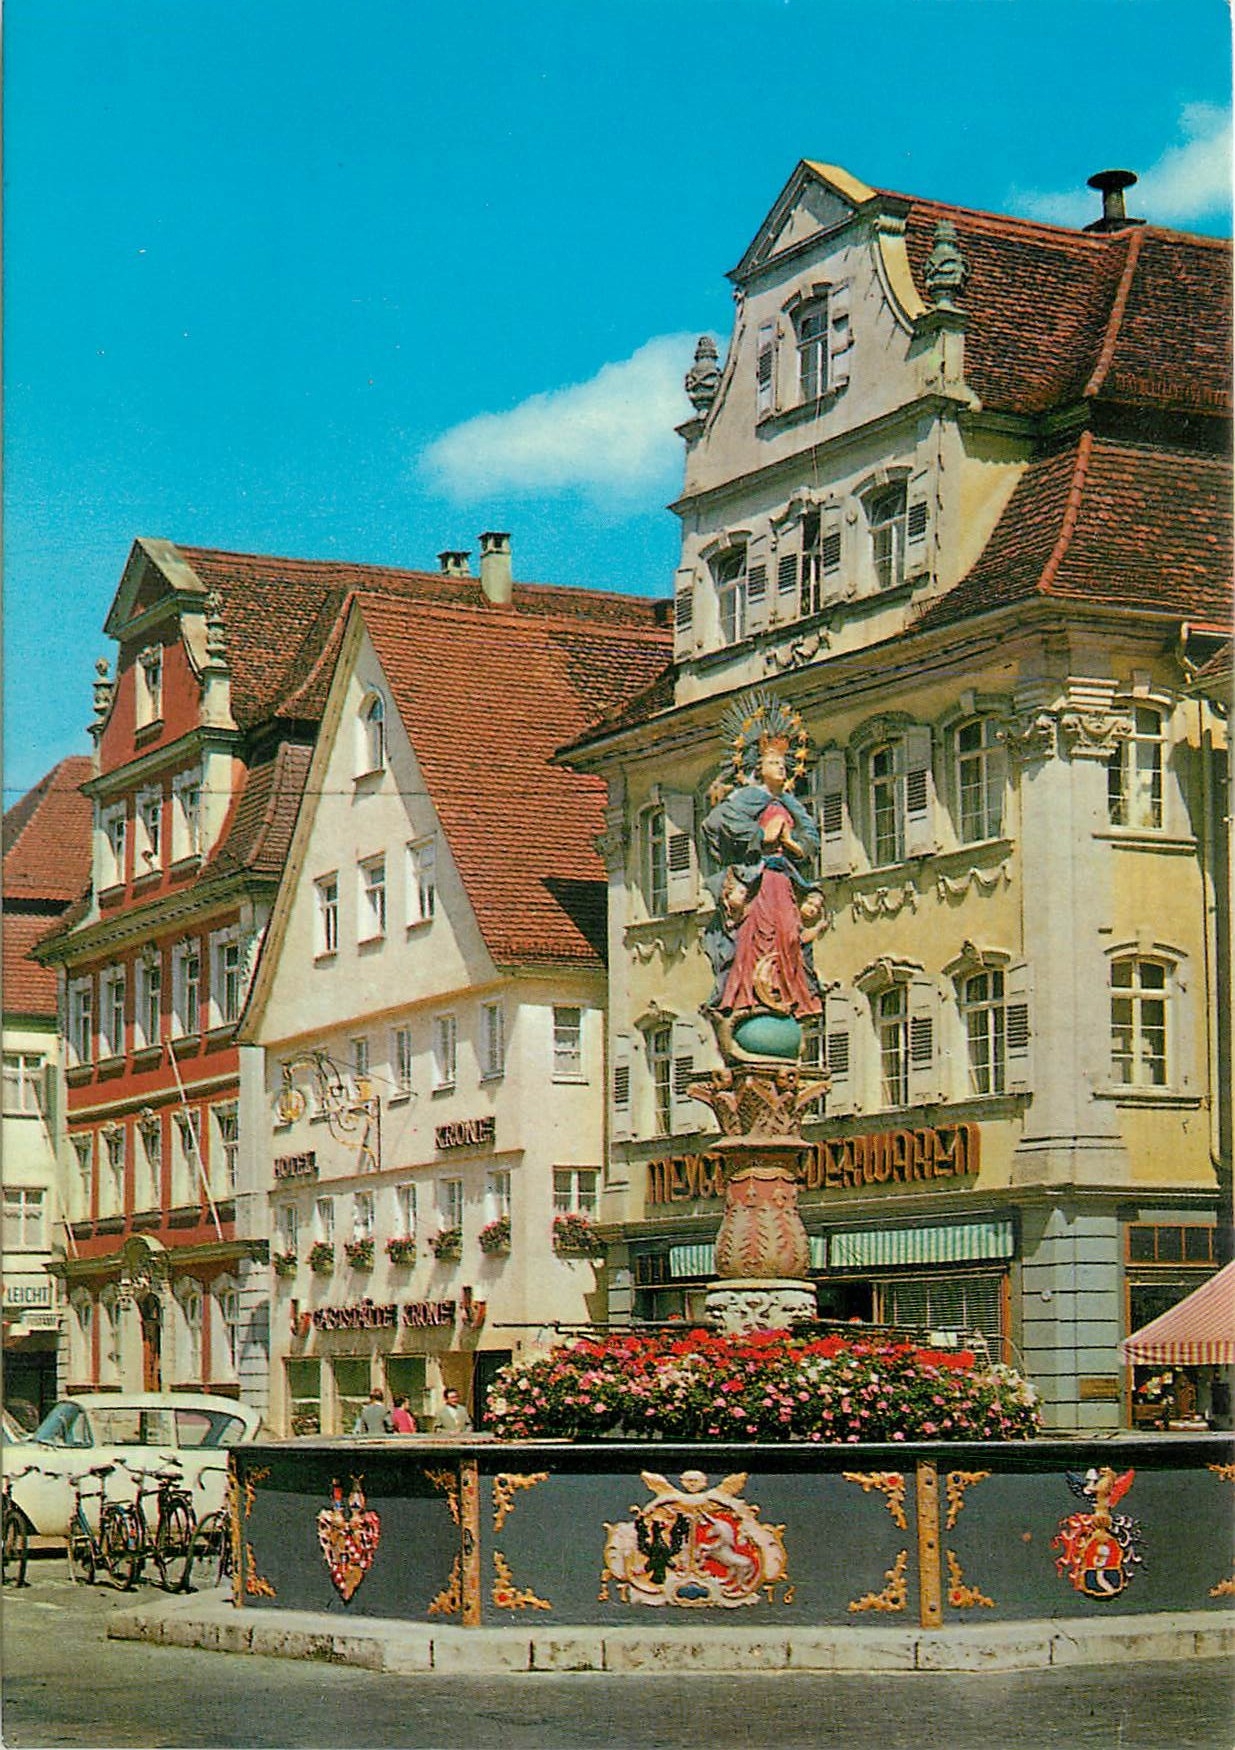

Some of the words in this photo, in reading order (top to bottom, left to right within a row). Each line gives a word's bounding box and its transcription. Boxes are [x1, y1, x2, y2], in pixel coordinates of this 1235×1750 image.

[273, 1151, 319, 1176] HOTEL
[434, 1116, 496, 1149] KRONE
[795, 1121, 981, 1192] DERWAREN
[8, 1286, 49, 1303] LEICHT
